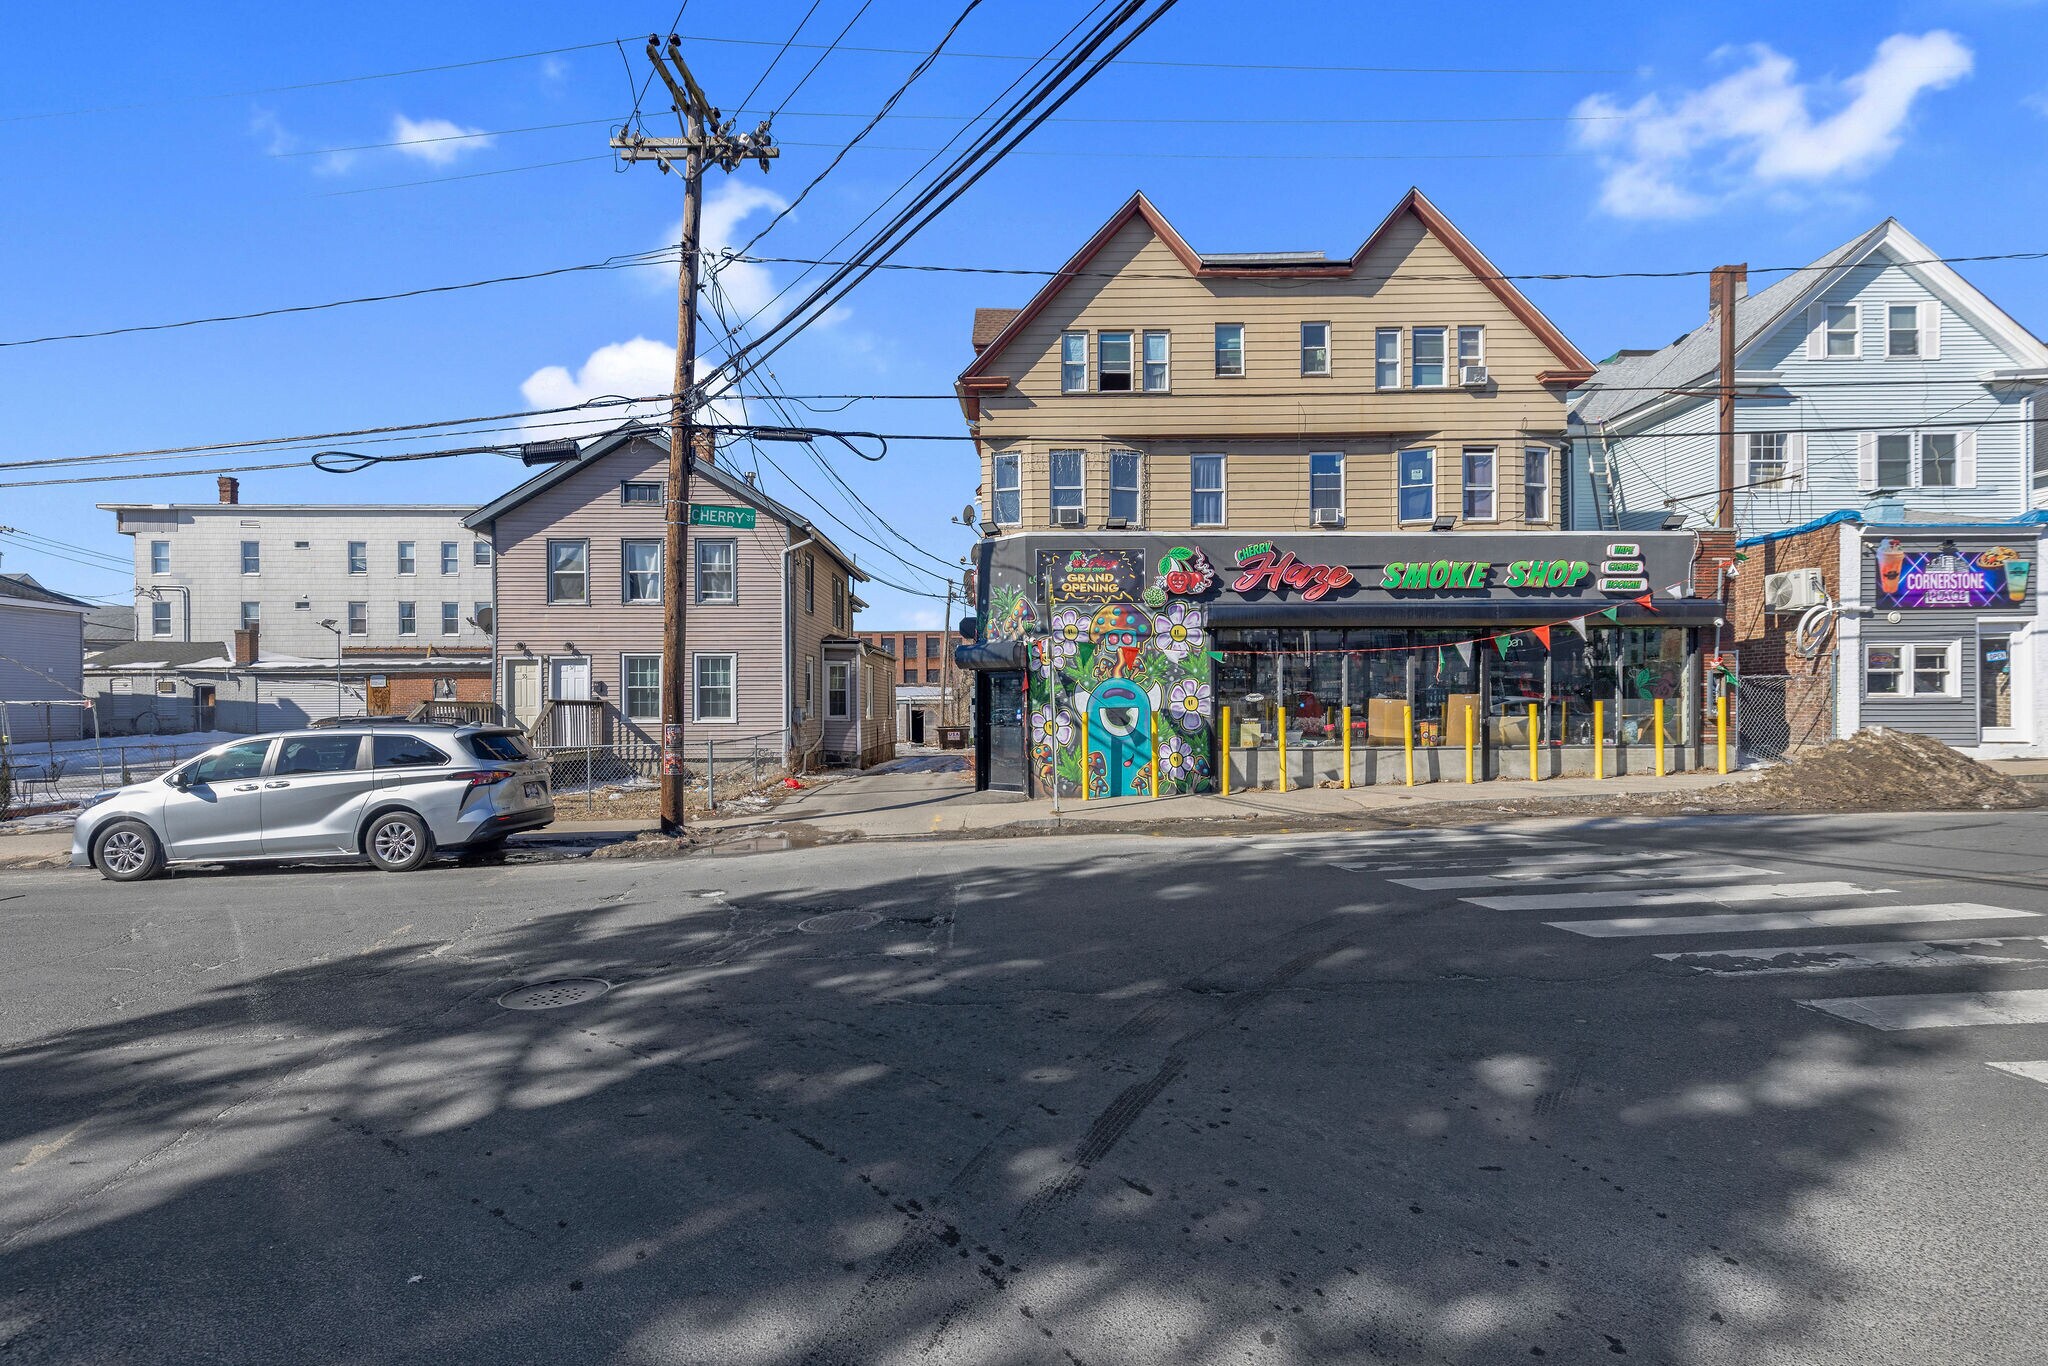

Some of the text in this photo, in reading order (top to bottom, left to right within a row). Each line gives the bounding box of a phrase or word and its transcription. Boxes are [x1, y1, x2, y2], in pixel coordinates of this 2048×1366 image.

[691, 508, 746, 524] CHERRY
[1236, 541, 1272, 561] CHERRY
[1613, 545, 1636, 555] VAPE
[1607, 562, 1640, 572] CIGARS
[1066, 573, 1115, 583] GRAND
[1232, 551, 1354, 602] Haze
[1380, 559, 1591, 589] SMOKE SHOP
[1605, 580, 1643, 590] HOOKAH
[1907, 573, 1985, 590] CORNERSTONE
[1061, 583, 1120, 593] OPENING
[1928, 589, 1966, 601] PLACE
